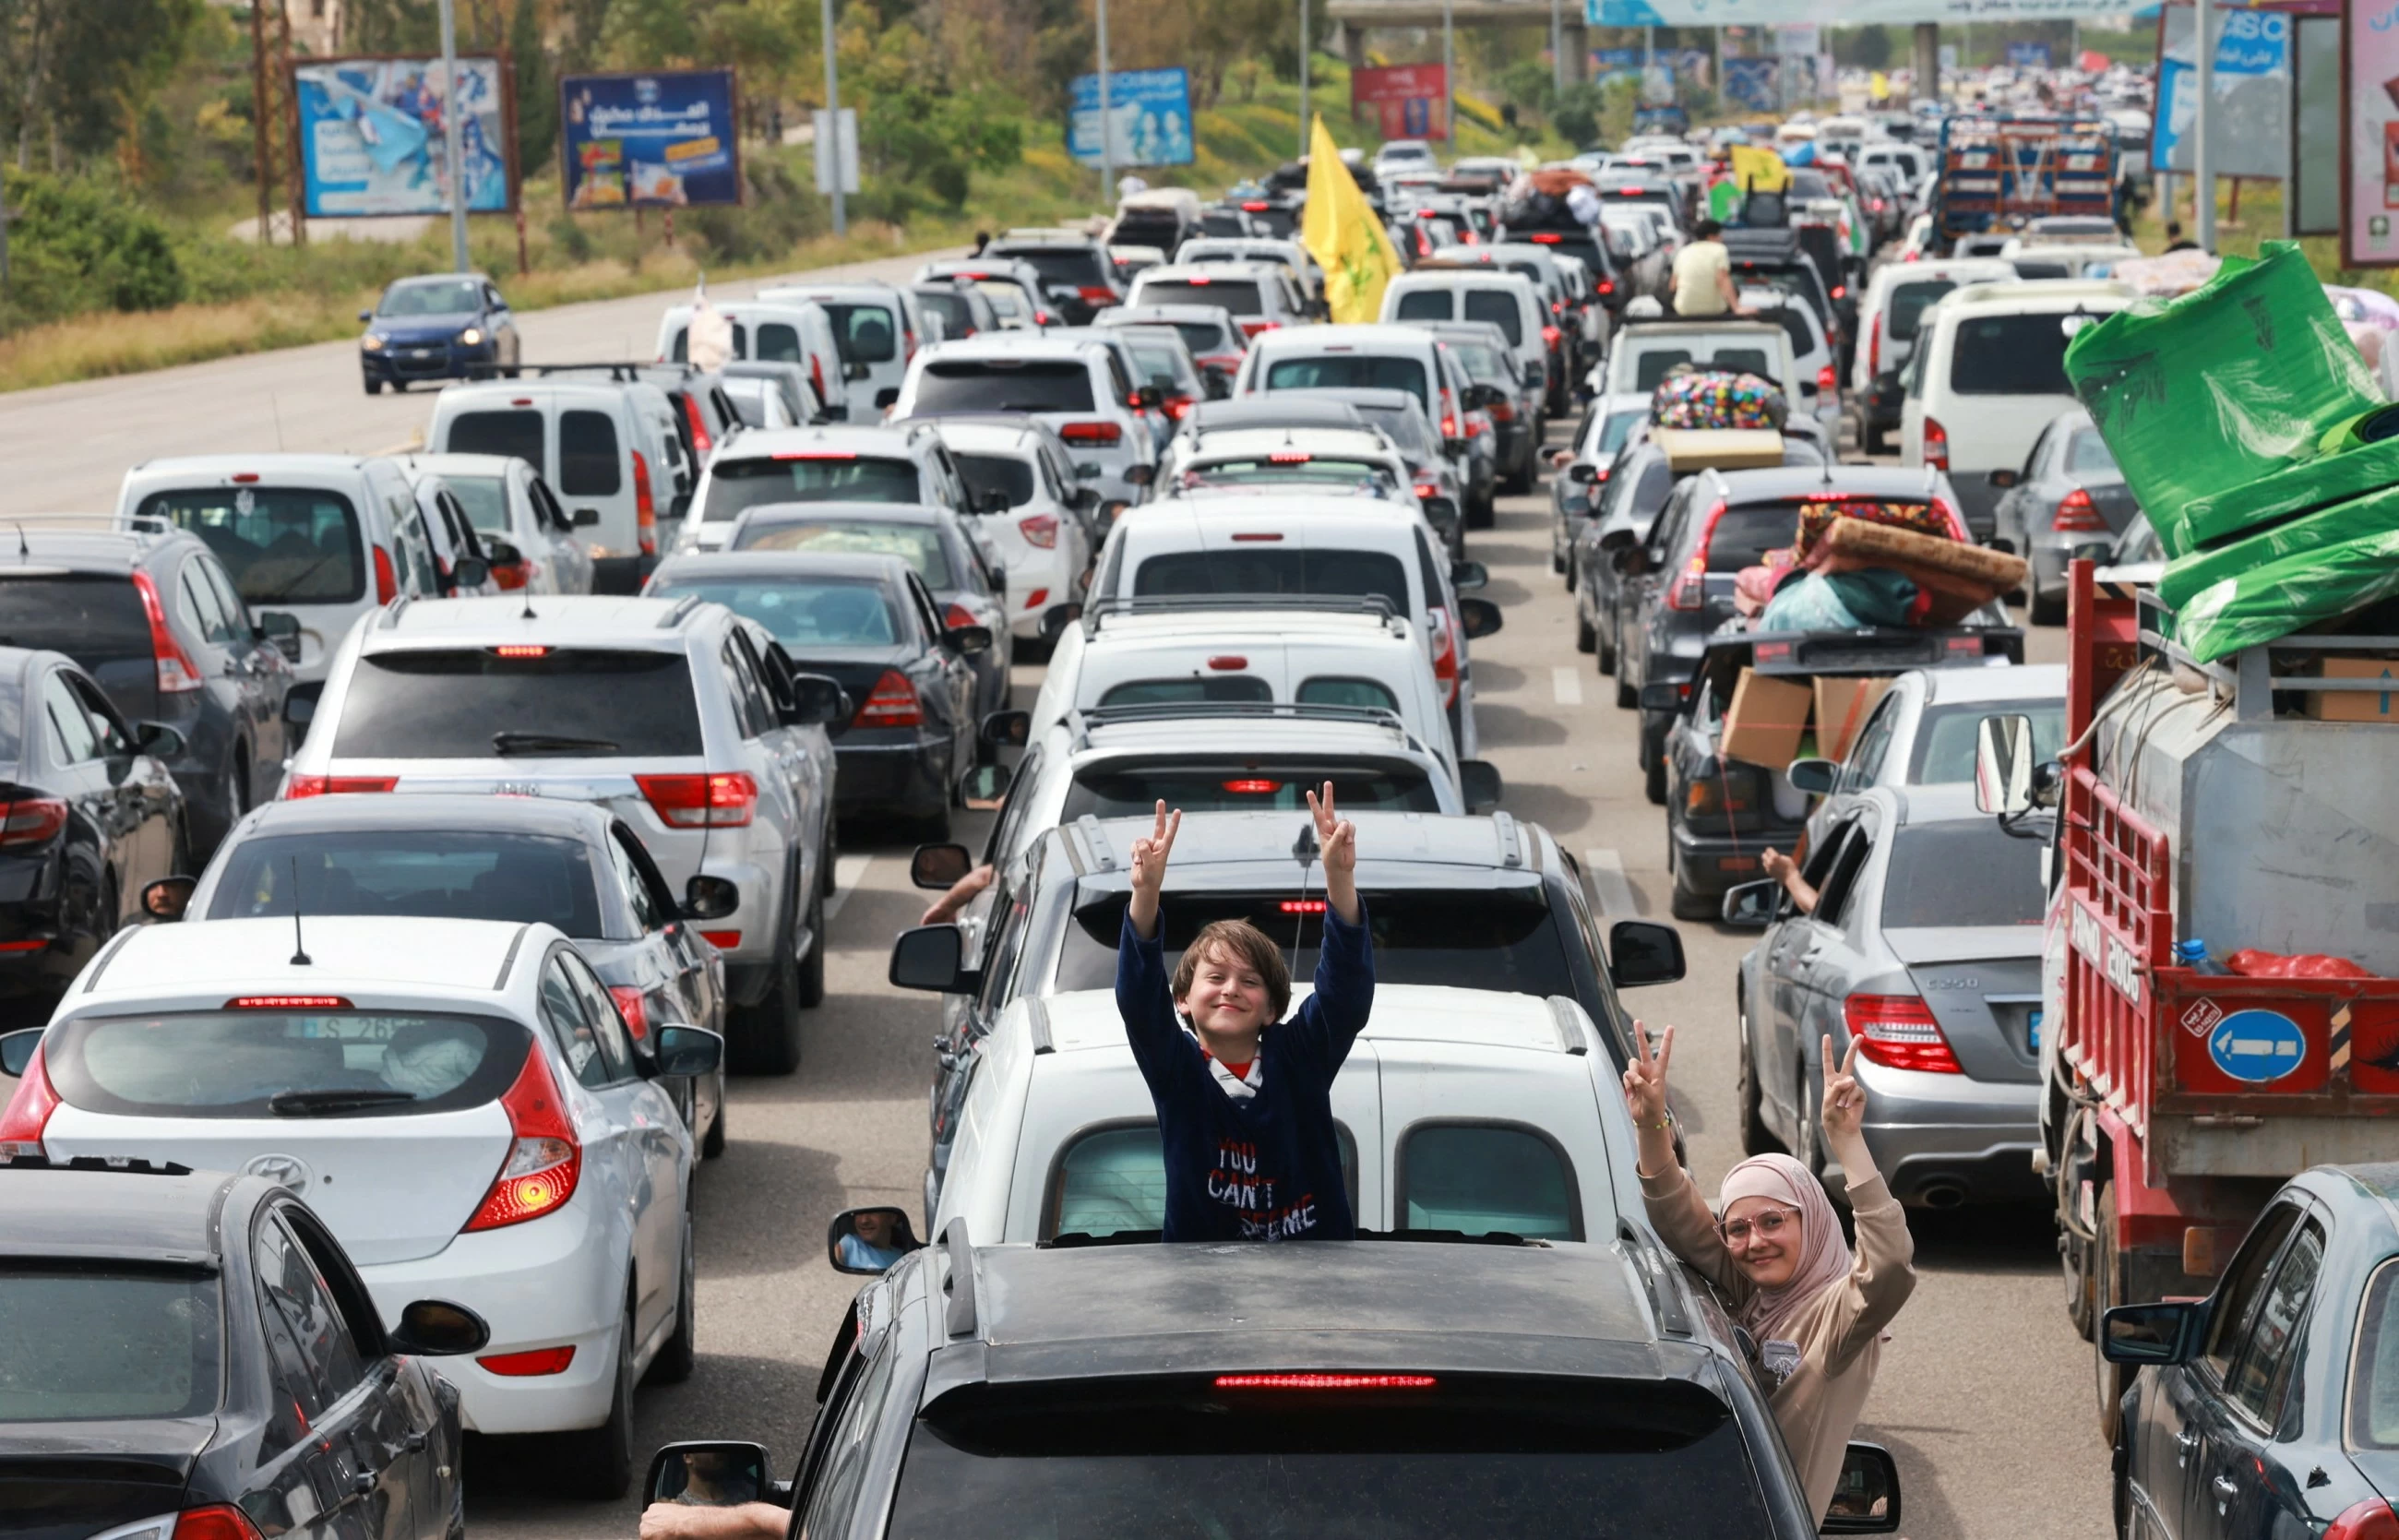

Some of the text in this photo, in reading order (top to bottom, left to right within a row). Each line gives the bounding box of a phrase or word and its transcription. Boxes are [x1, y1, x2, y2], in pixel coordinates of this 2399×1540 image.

[2072, 901, 2100, 962] HINO
[1217, 1137, 1257, 1175] YOU
[1207, 1169, 1277, 1210] CAN'T
[1282, 1193, 1318, 1236] ME
